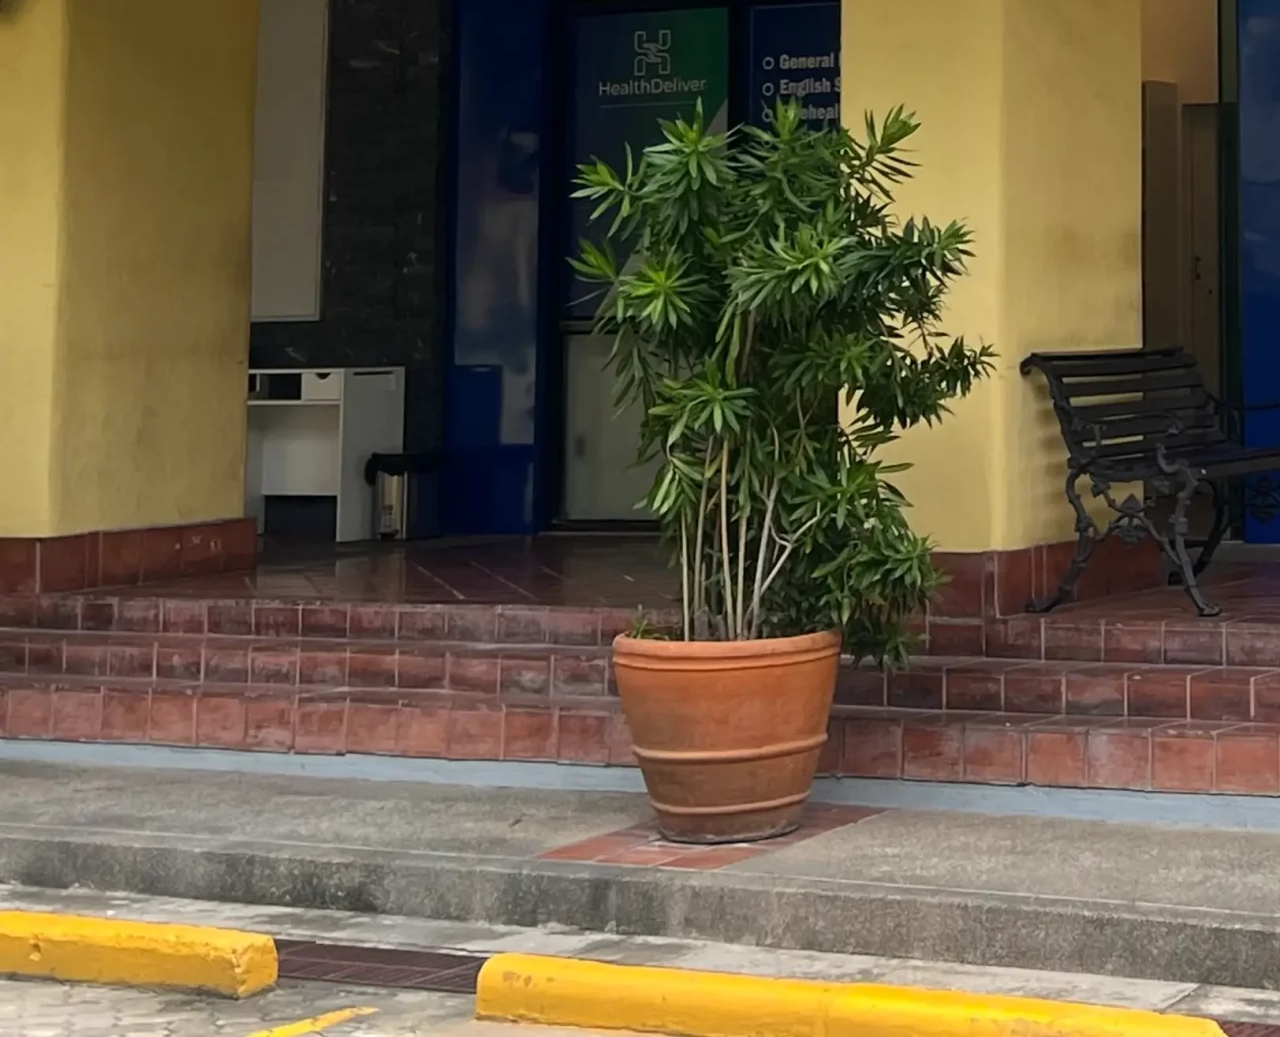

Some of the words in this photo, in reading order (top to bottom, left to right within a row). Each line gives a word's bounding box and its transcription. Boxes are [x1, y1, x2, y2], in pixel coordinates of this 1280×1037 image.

[779, 52, 835, 71] General
[598, 77, 708, 97] HealthDeliver
[779, 77, 832, 98] English
